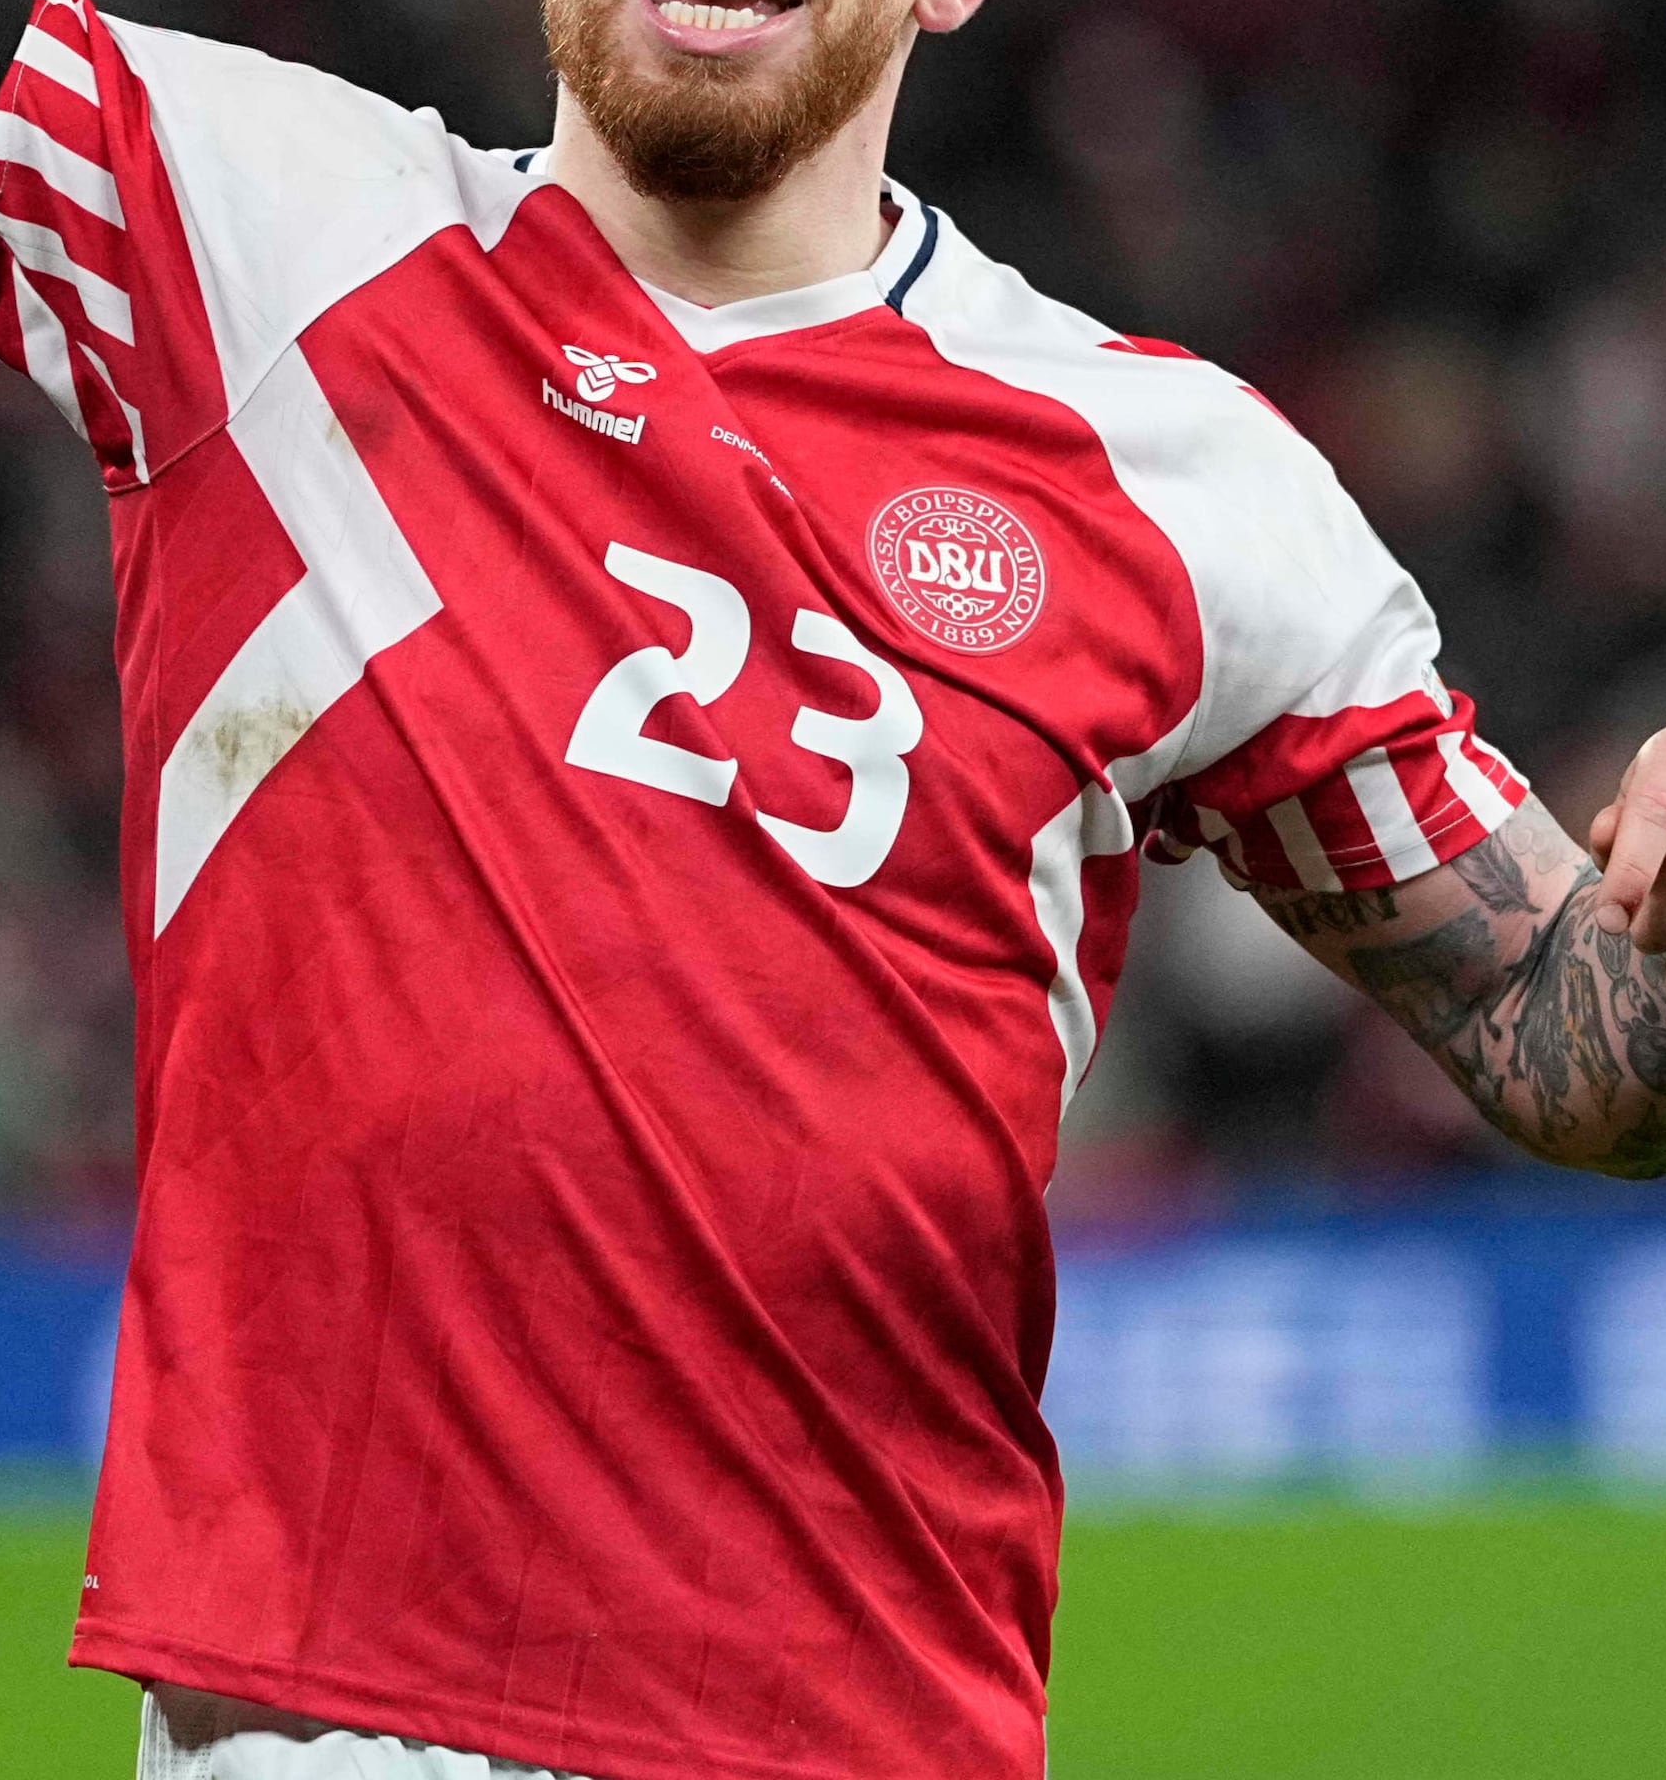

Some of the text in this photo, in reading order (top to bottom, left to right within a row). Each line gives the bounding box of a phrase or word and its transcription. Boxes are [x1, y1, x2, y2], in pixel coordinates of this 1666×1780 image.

[542, 378, 646, 445] hummel
[711, 426, 774, 471] DENMA
[876, 522, 920, 616] DANSK
[905, 539, 1007, 593] DBU
[929, 618, 995, 646] 1889
[565, 541, 924, 888] 23
